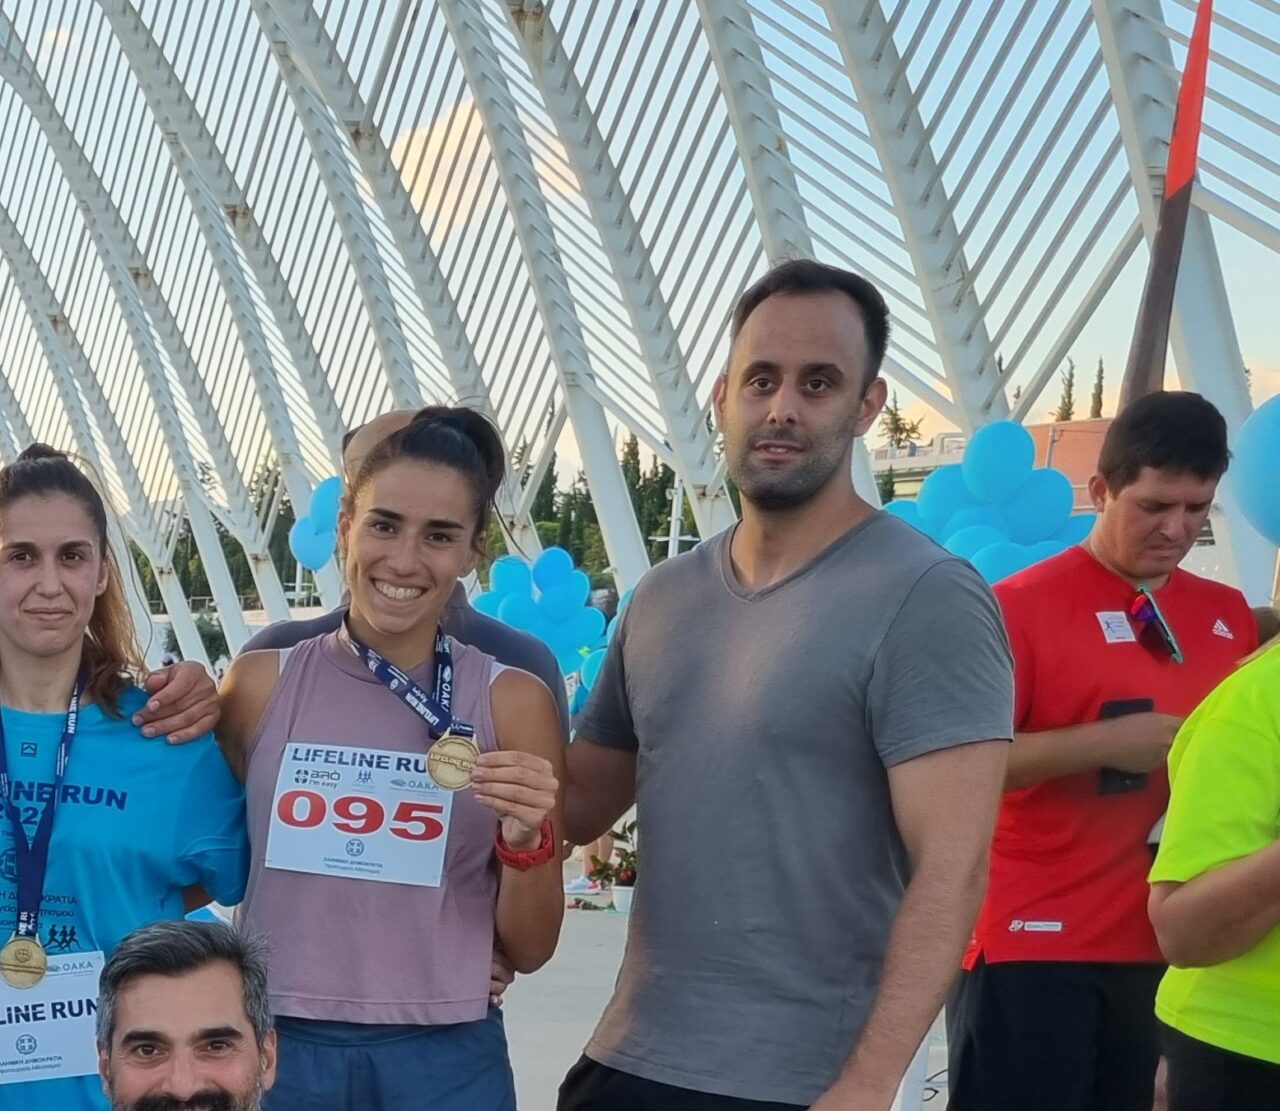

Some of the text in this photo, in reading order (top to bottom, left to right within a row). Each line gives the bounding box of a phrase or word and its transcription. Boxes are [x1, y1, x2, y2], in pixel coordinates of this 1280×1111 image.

[292, 748, 428, 774] LIFELINE RU
[61, 785, 127, 811] RUN
[277, 790, 444, 841] 095
[63, 961, 93, 971] OAKA
